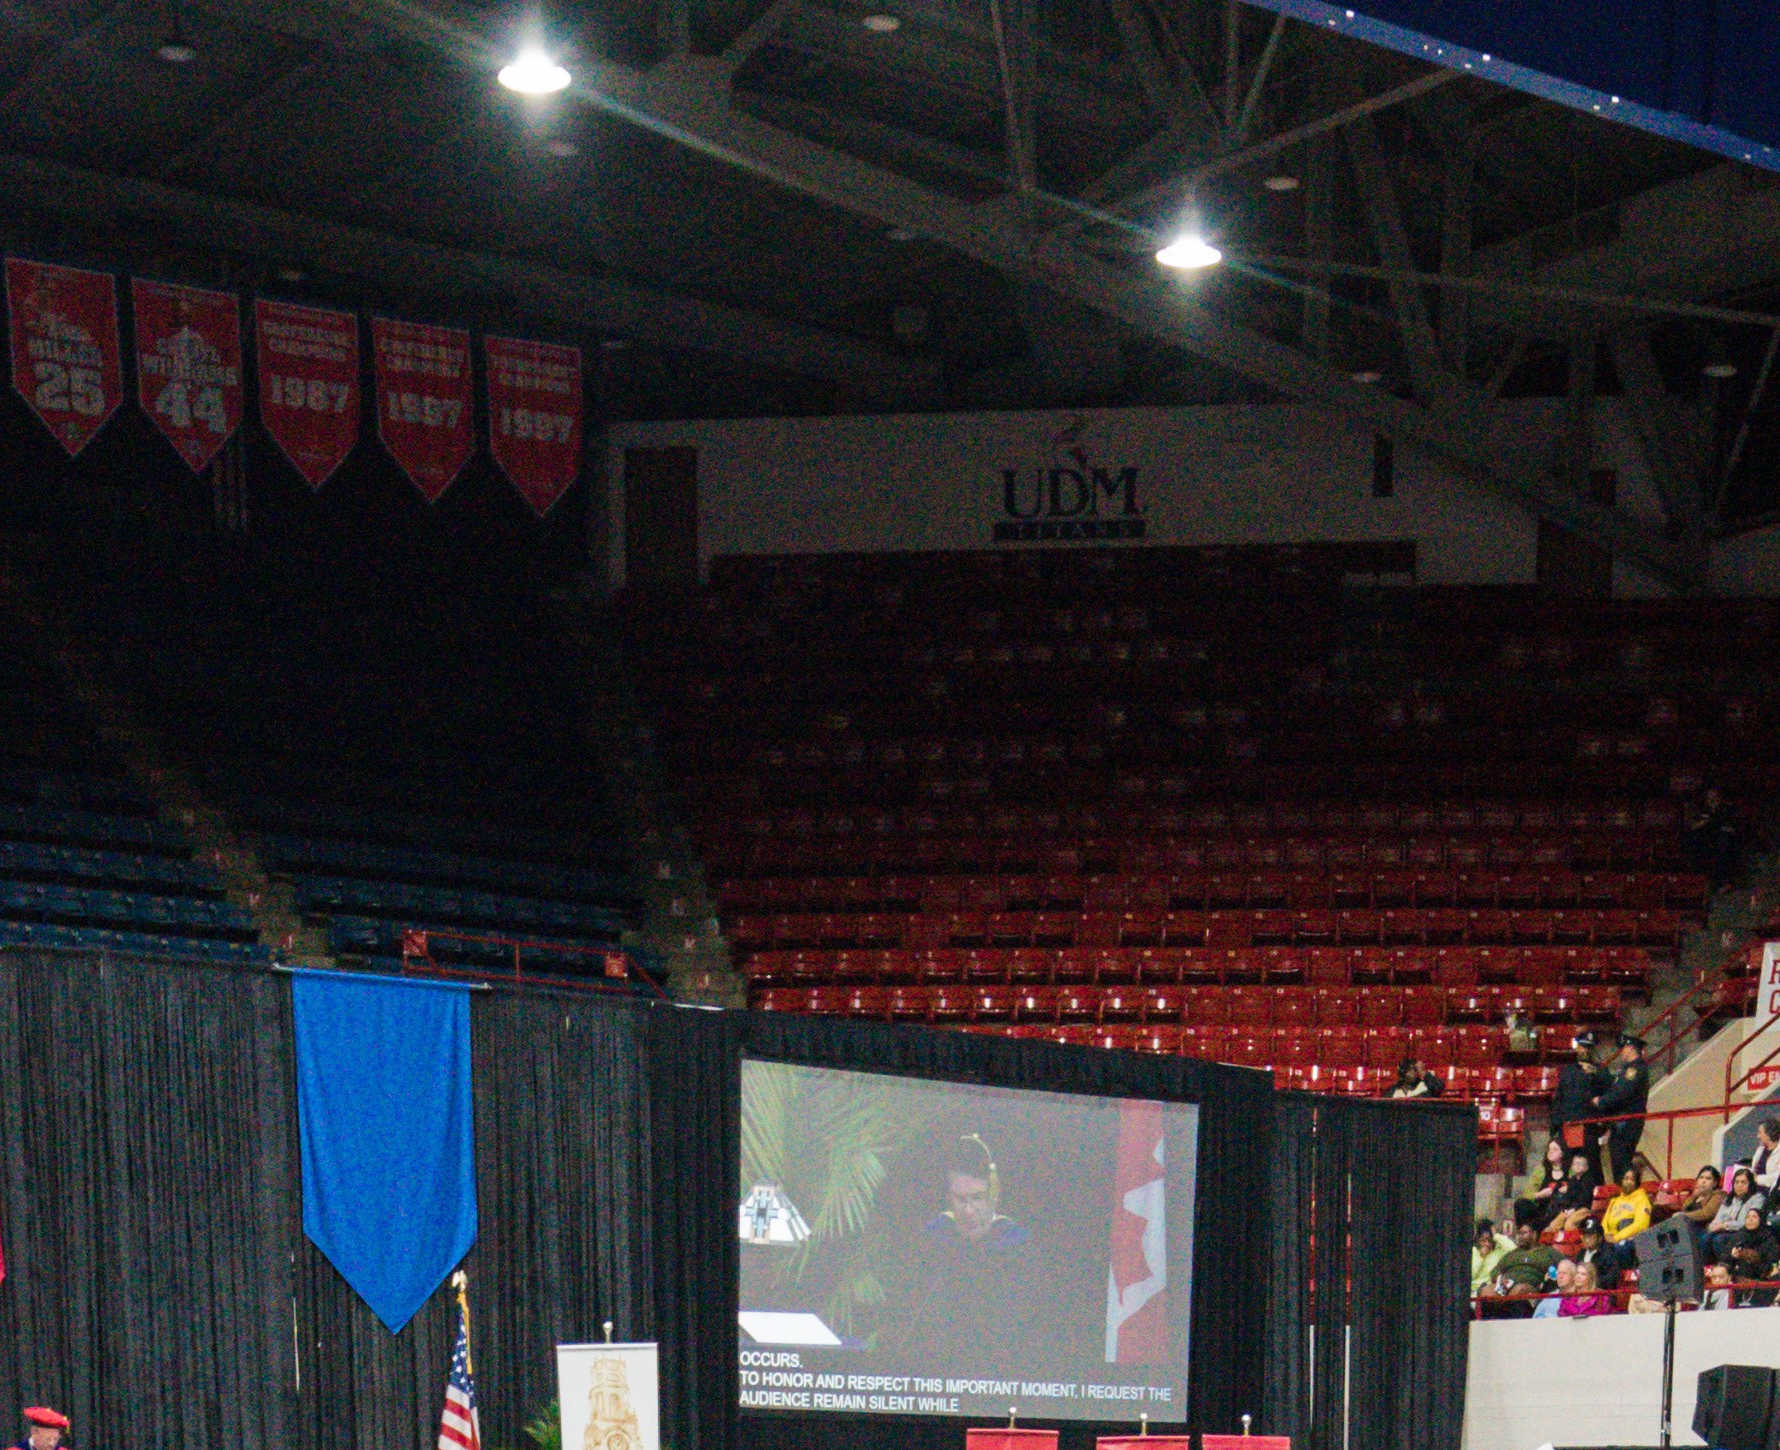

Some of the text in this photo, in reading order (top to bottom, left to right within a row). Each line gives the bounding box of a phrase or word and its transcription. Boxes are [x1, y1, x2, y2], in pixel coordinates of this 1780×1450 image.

[33, 362, 105, 416] 25
[154, 381, 226, 433] 44
[1002, 467, 1141, 518] UDM
[740, 1351, 803, 1369] OCCURS.
[740, 1370, 760, 1386] TO
[762, 1371, 813, 1388] HONOR
[815, 1374, 845, 1390] AND
[847, 1375, 910, 1392] RESPECT
[913, 1377, 943, 1393] THIS
[946, 1378, 1019, 1396] IMPORTANT
[1021, 1382, 1079, 1400] MOMENT,
[1088, 1385, 1145, 1402] REQUEST
[1148, 1386, 1171, 1402] THE
[740, 1390, 960, 1413] AUDIENCE REMAIN SILENT WHILE
